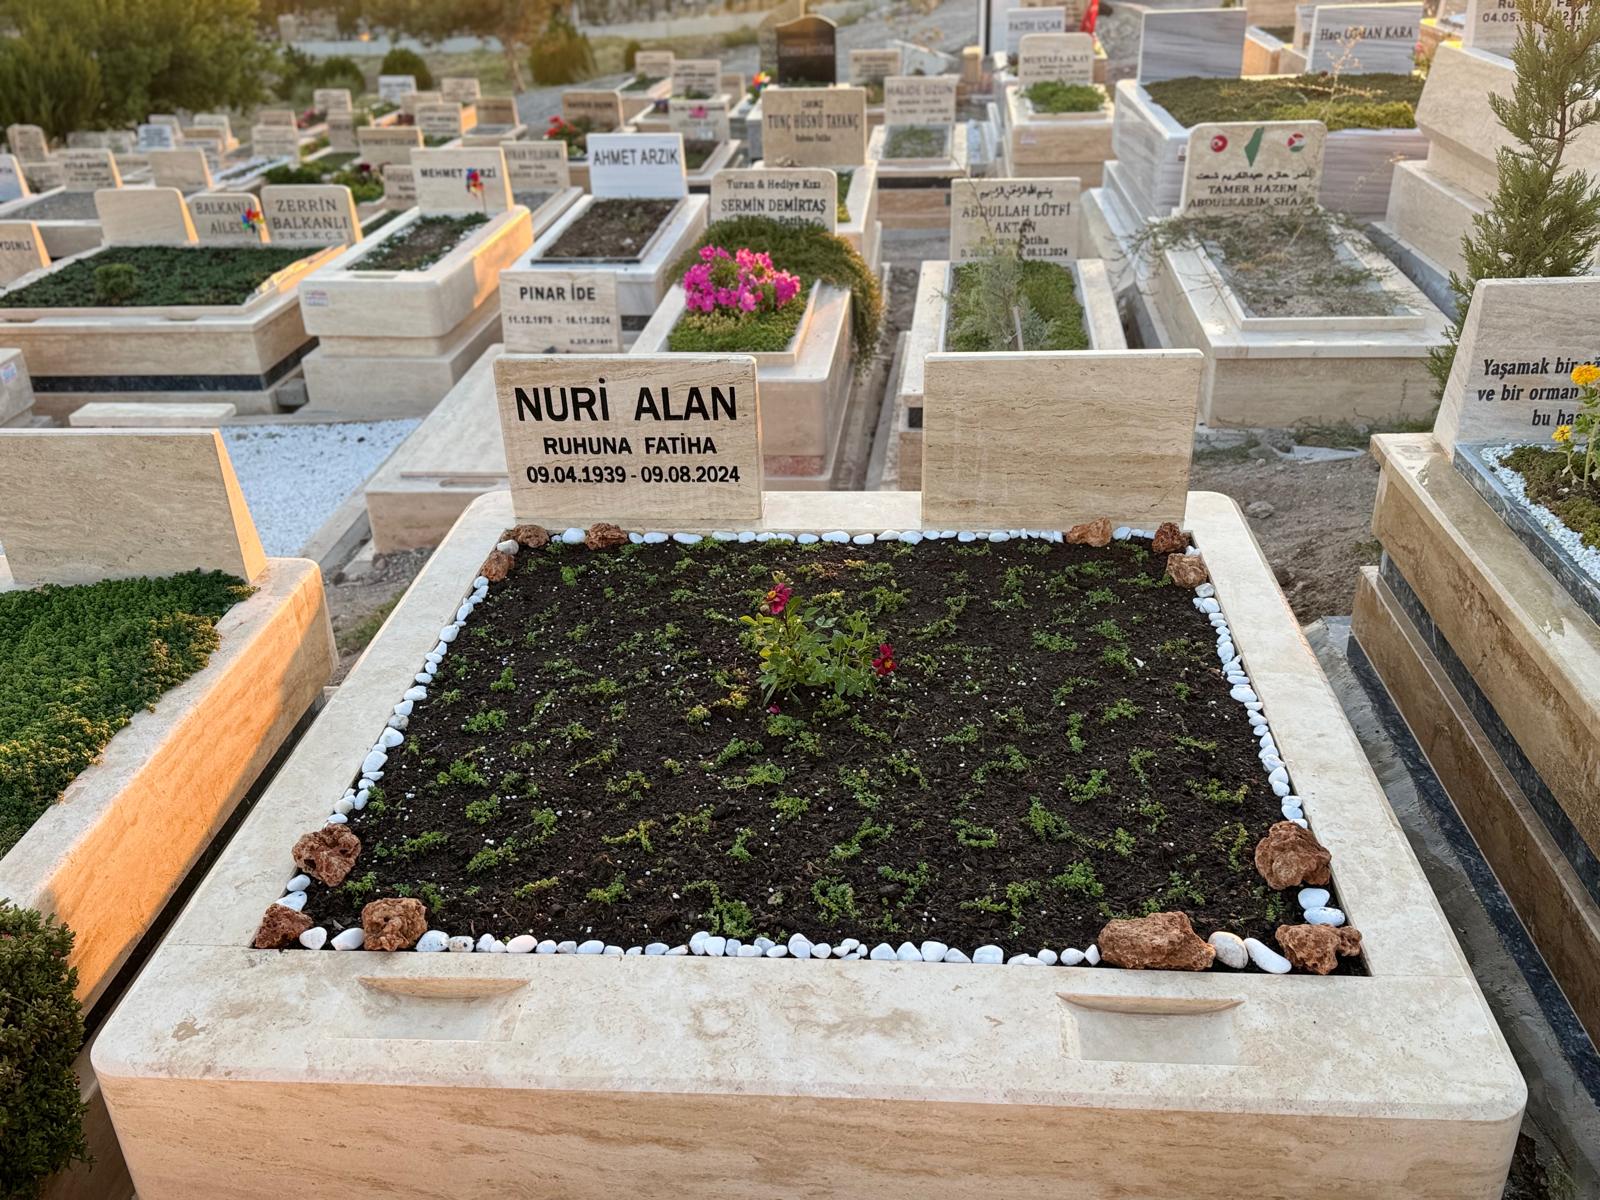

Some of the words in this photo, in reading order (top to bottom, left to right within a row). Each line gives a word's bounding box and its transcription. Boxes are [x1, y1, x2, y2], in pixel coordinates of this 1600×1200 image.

[1384, 26, 1413, 39] KARA
[593, 148, 637, 165] AHMET
[640, 147, 679, 165] ARZIK
[420, 168, 463, 179] MEHMET
[726, 179, 756, 190] Turan
[757, 179, 765, 190] &
[767, 179, 800, 192] Hediye
[1208, 184, 1251, 195] TAMER
[1253, 183, 1298, 194] HAZEM
[275, 196, 338, 213] ZERRİN
[721, 197, 765, 212] SERMİN
[768, 197, 827, 215] DEMİRTAŞ
[961, 204, 1031, 219] ABDULLAH
[1033, 201, 1071, 217] LÜTFİ
[210, 220, 255, 235] AİLES
[271, 215, 348, 231] BALKANLI
[519, 286, 567, 301] PINAR
[570, 282, 596, 301] İDE
[1483, 356, 1550, 380] Yaşamak
[1554, 356, 1578, 374] bir
[514, 377, 610, 421] NURİ
[634, 386, 738, 421] ALAN
[1477, 388, 1496, 401] ve
[1500, 383, 1524, 401] bir
[1528, 386, 1579, 401] orman
[1531, 408, 1551, 426] bu
[543, 436, 632, 455] RUHUNA
[644, 432, 718, 455] FATİHA
[526, 465, 627, 484] 09.04.1939
[640, 465, 741, 484] 09.08.2024
